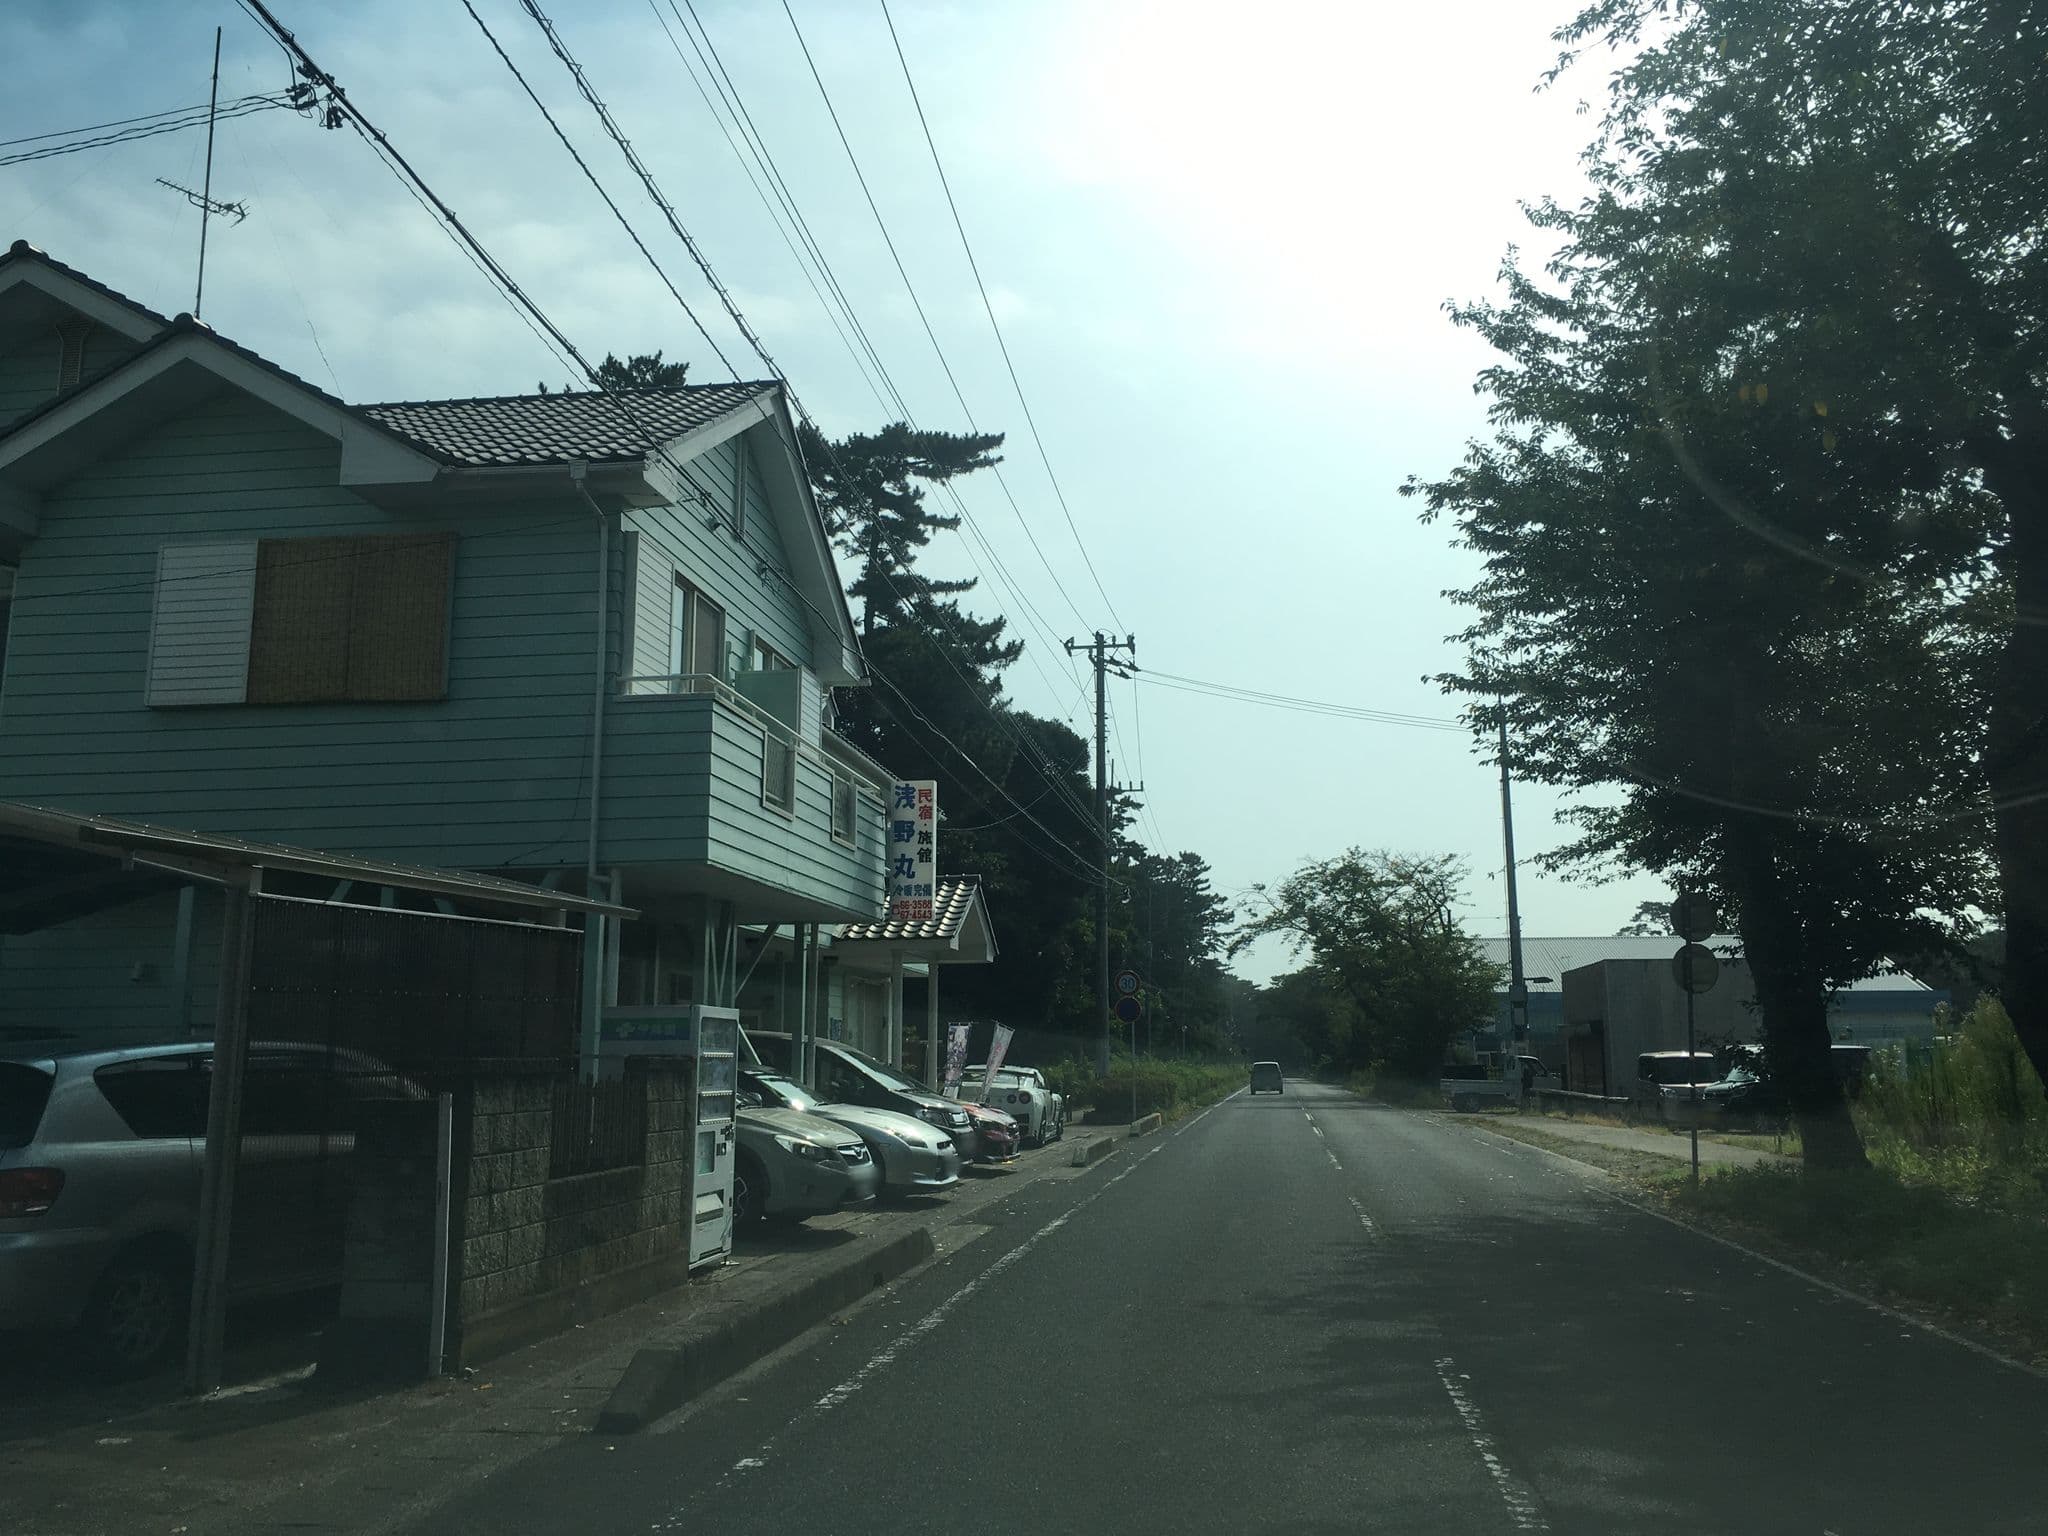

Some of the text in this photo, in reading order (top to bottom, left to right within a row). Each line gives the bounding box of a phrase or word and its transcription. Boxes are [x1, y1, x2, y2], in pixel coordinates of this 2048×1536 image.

[893, 784, 916, 879] 浅野丸
[917, 789, 932, 864] 民宿・旅館
[1120, 977, 1136, 990] 30
